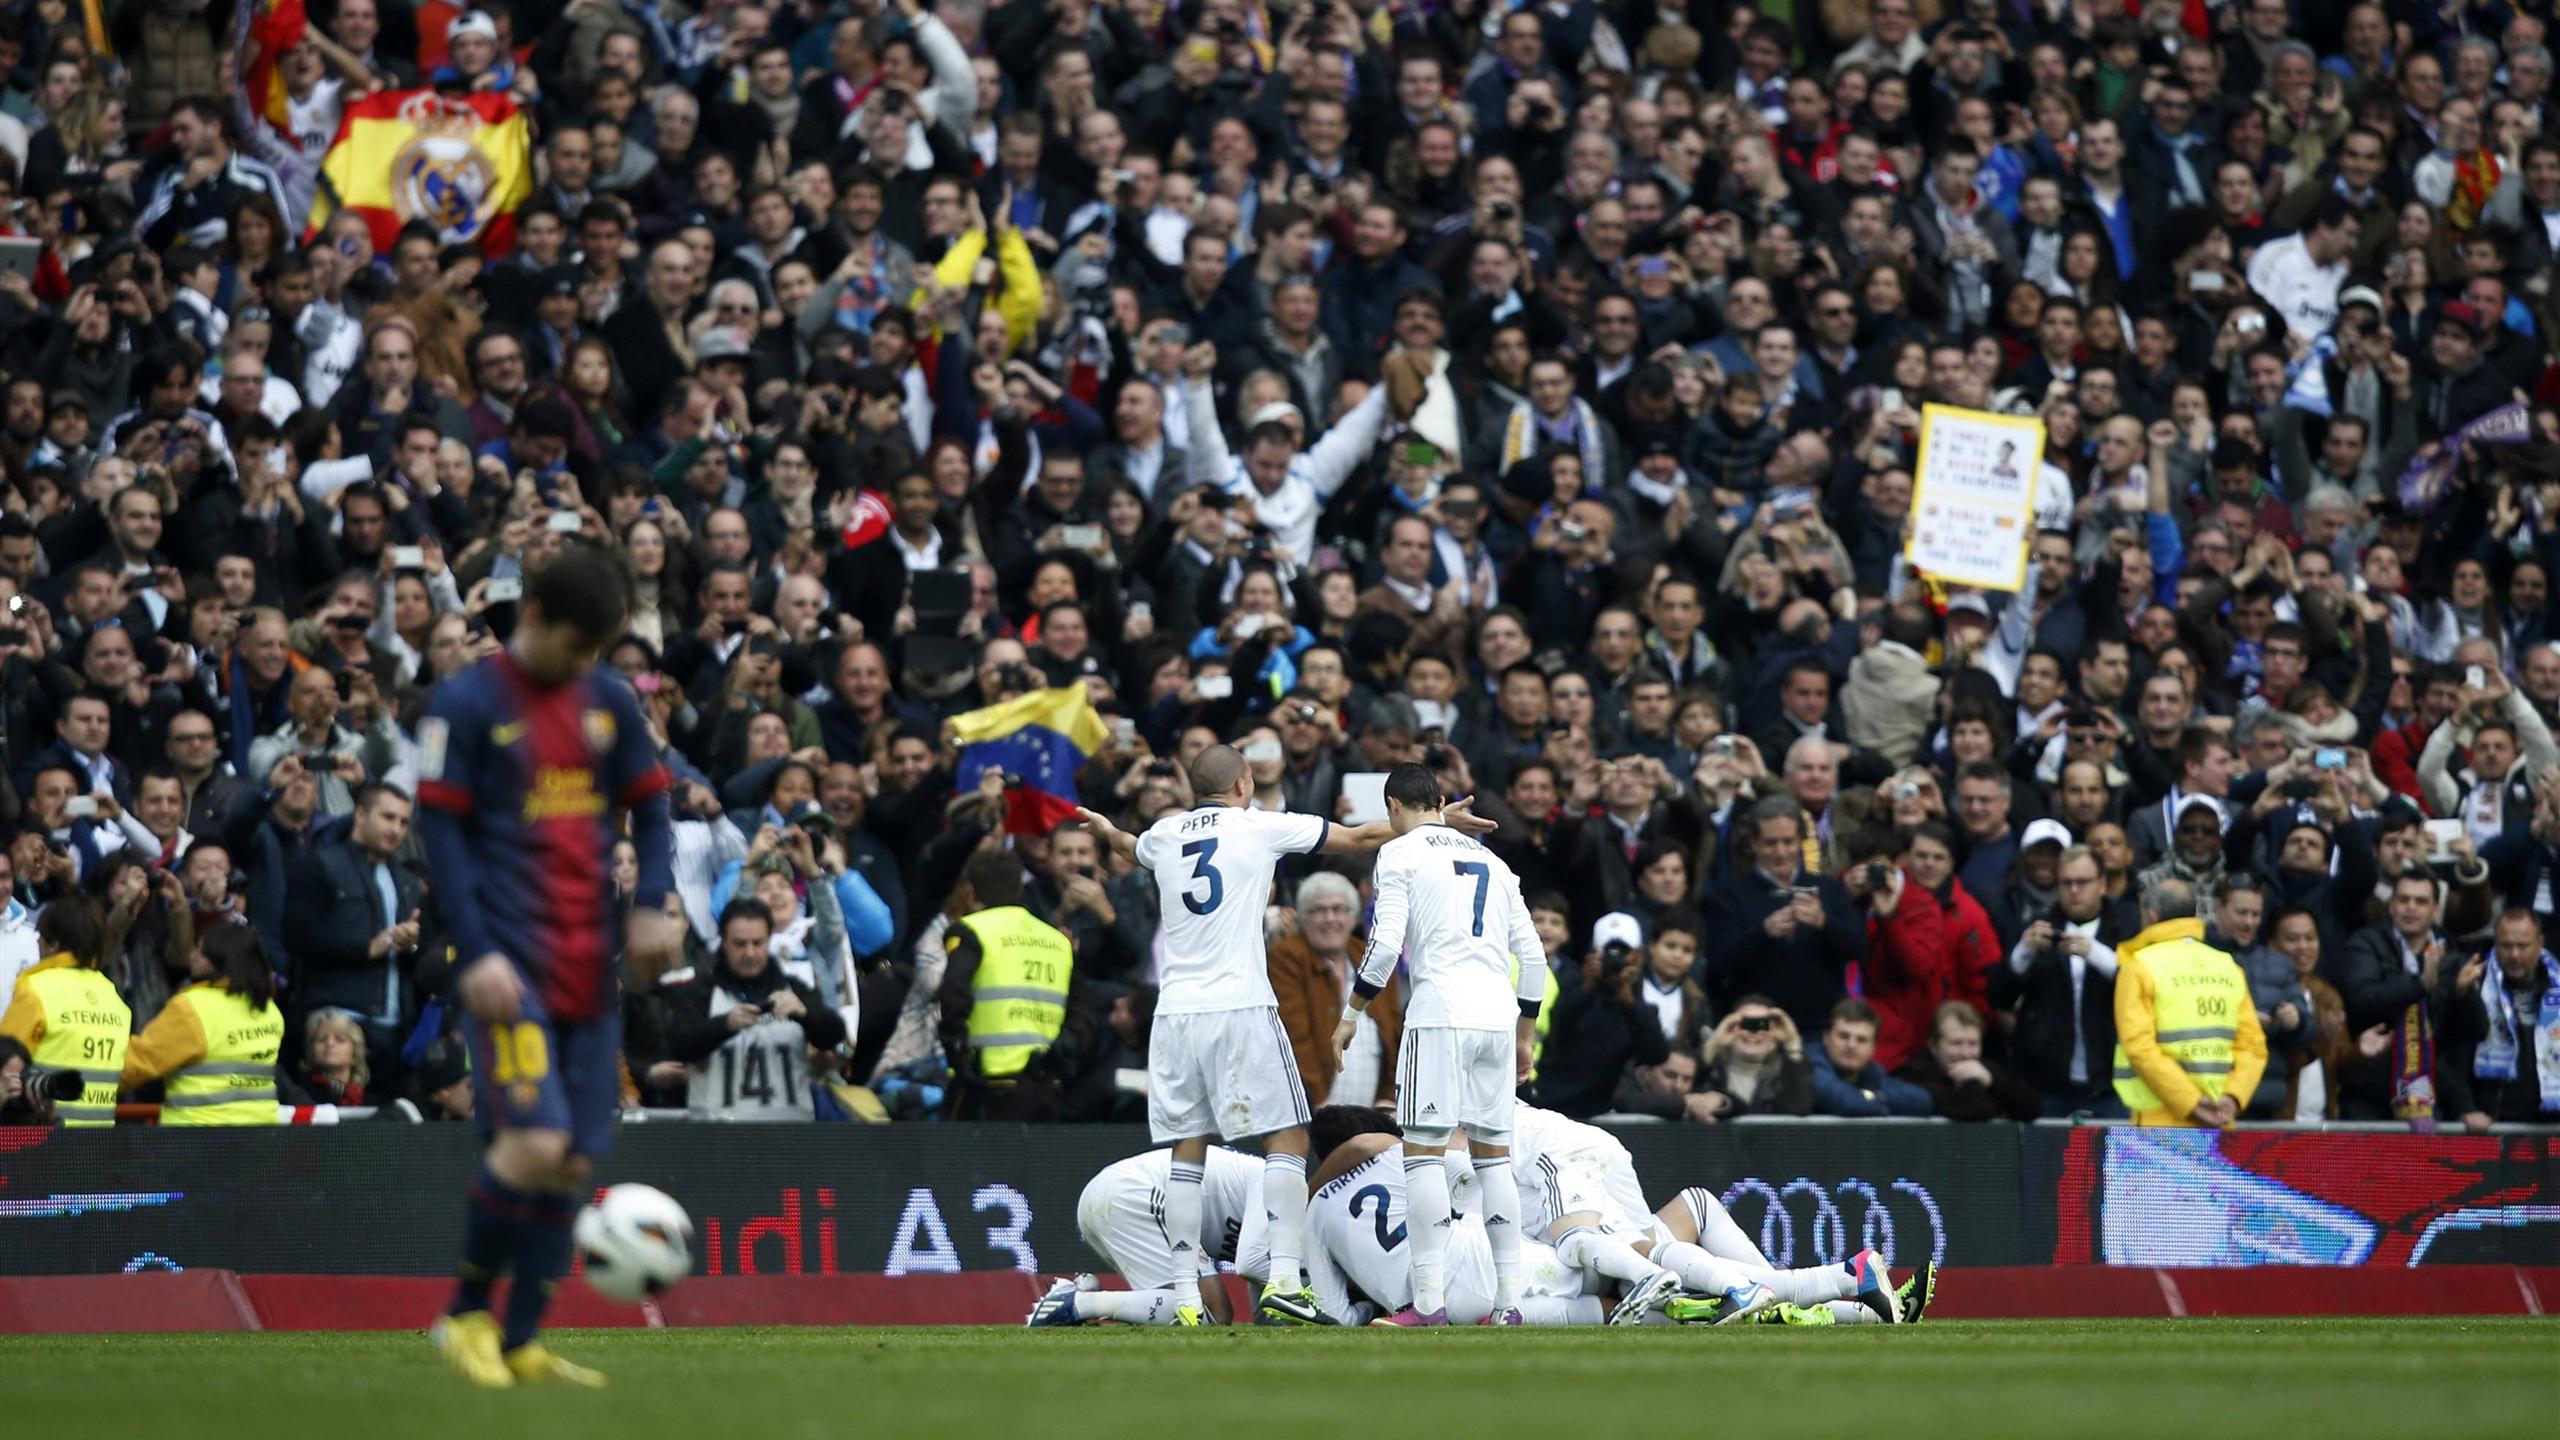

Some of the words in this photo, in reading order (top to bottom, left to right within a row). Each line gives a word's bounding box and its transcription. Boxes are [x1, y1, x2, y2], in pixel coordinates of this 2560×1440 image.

[1180, 812, 1220, 834] PEPE
[1181, 837, 1224, 916] 3
[1452, 860, 1490, 937] 7
[2196, 995, 2226, 1016] 800
[83, 1036, 116, 1061] 917
[490, 1021, 549, 1085] 10
[720, 1042, 798, 1108] 141
[883, 1184, 1038, 1277] A3
[1348, 1183, 1409, 1253] 2
